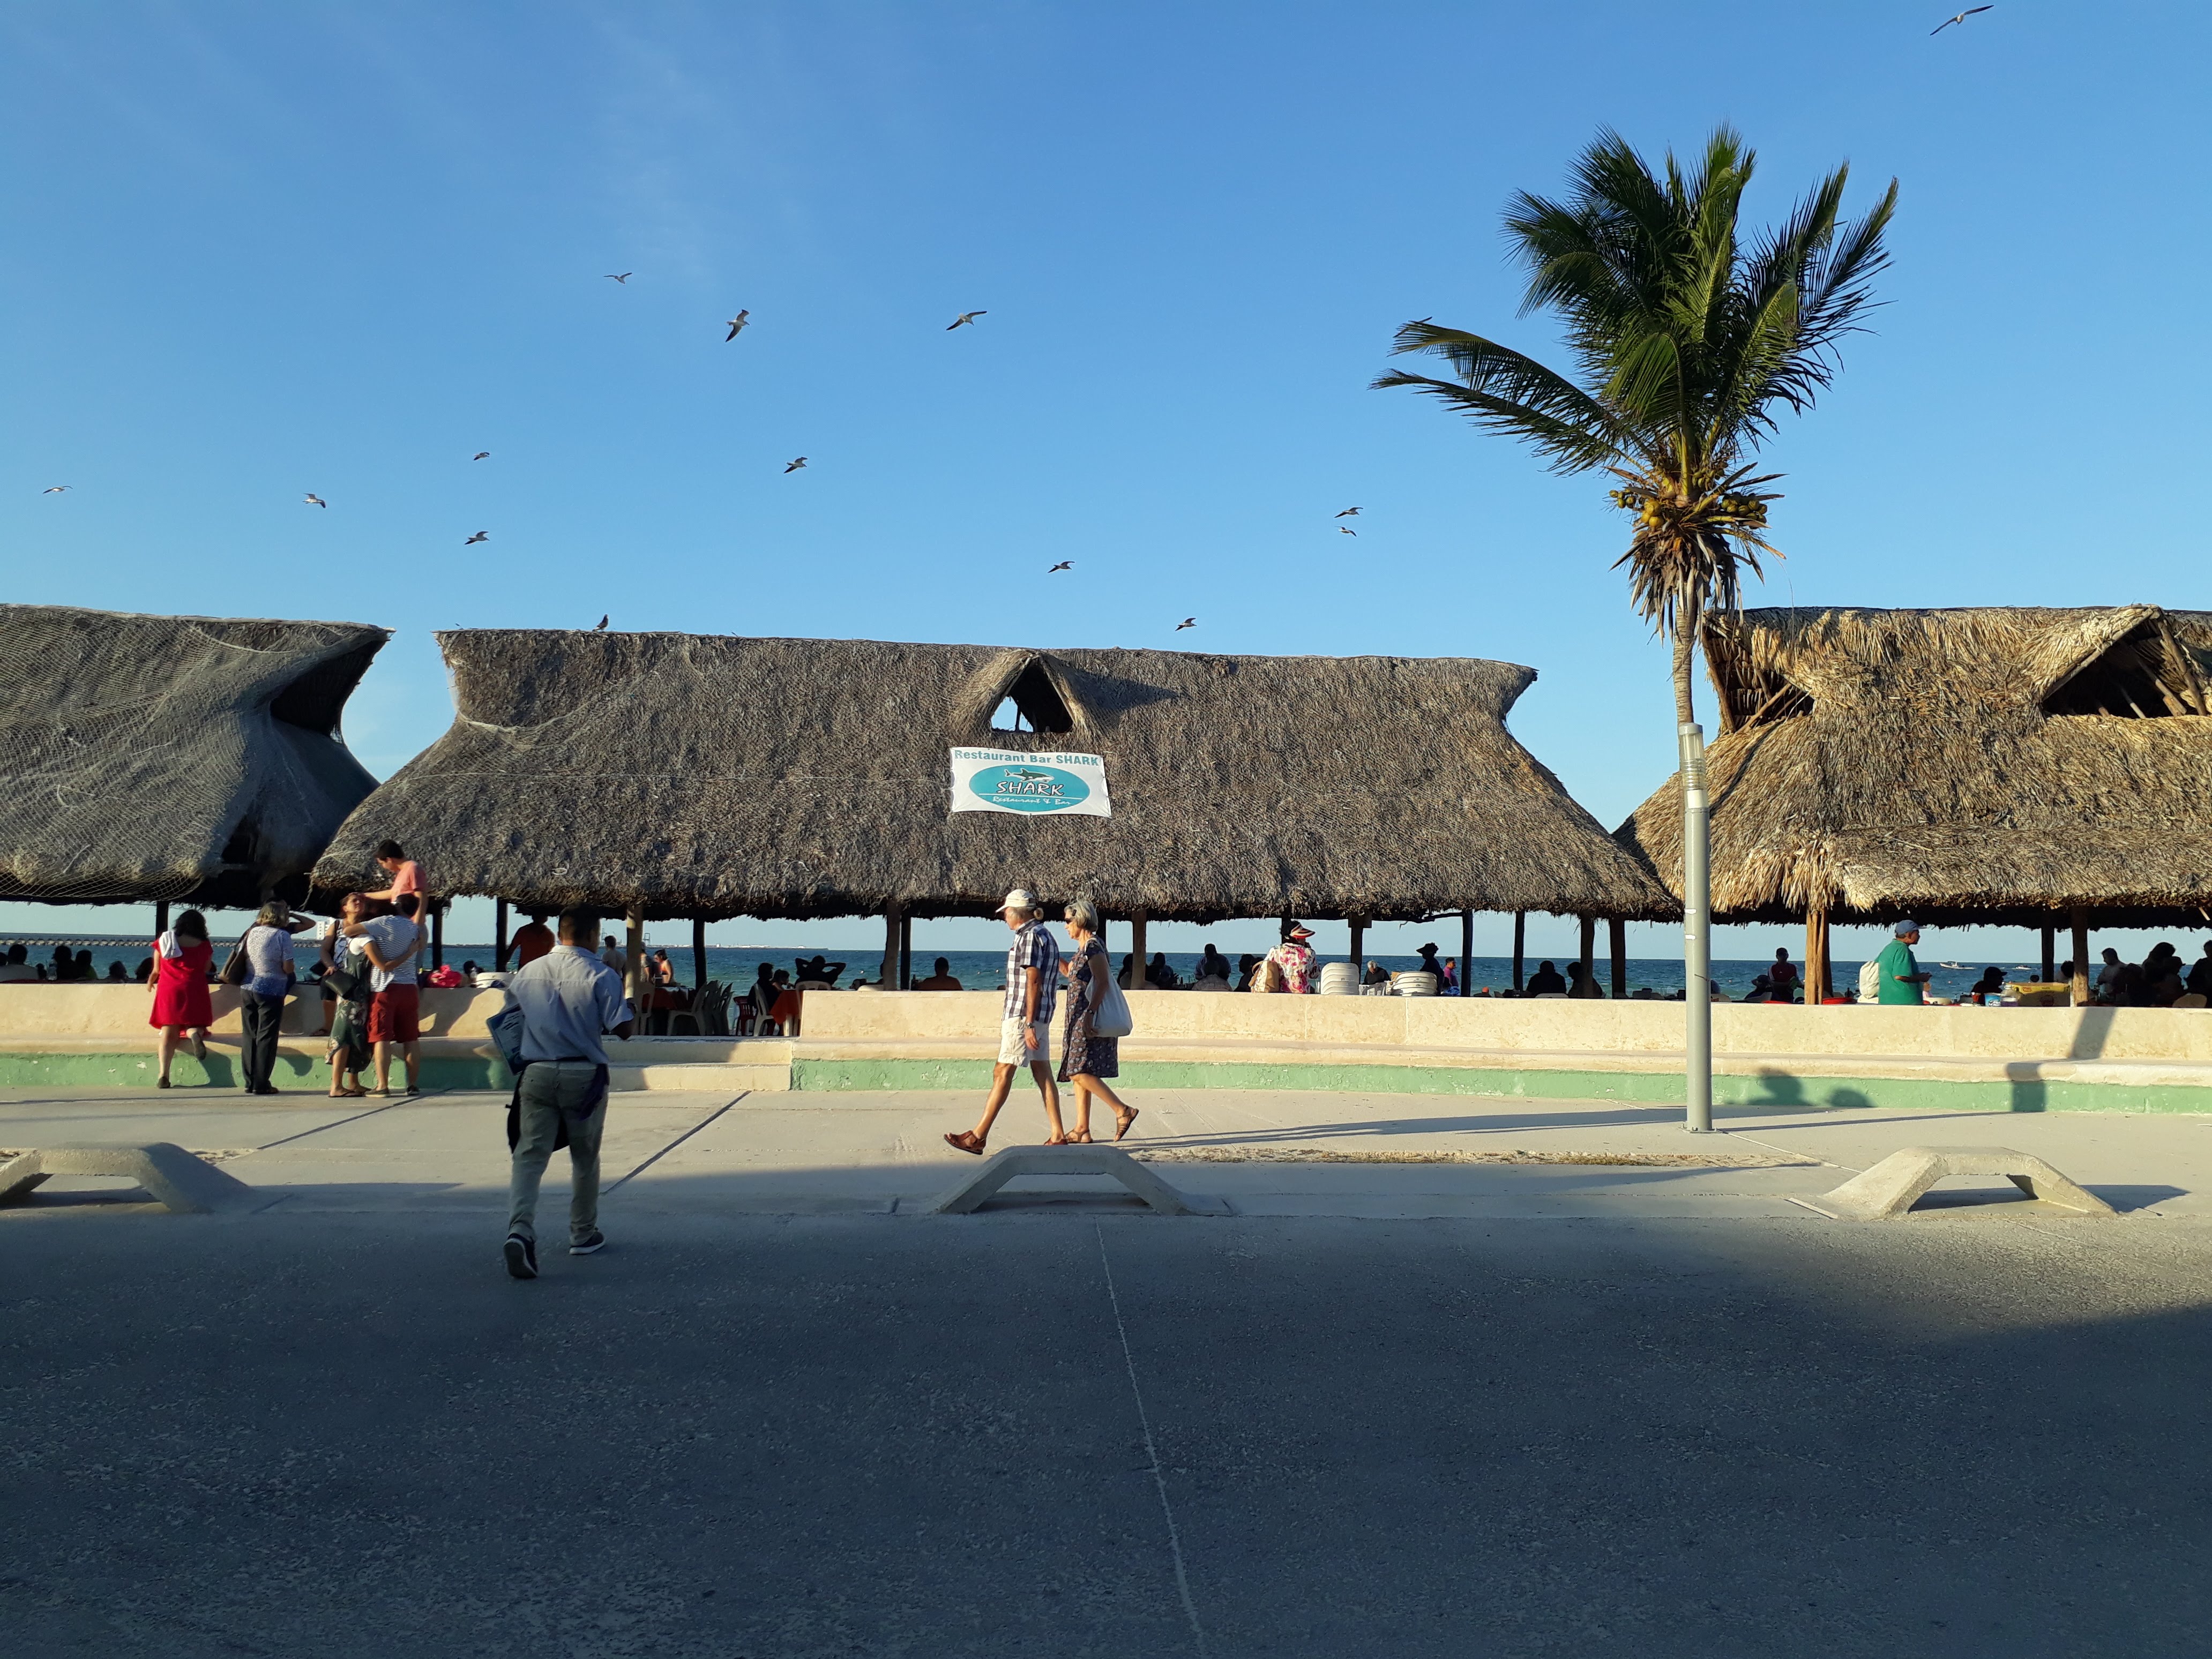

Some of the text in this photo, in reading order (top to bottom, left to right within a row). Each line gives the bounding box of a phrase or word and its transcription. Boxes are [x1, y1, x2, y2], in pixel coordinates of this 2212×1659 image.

[954, 750, 1025, 761] Restaurant
[1056, 755, 1099, 766] SHARK
[997, 781, 1064, 796] SHARK
[992, 796, 1041, 804] Restaurant
